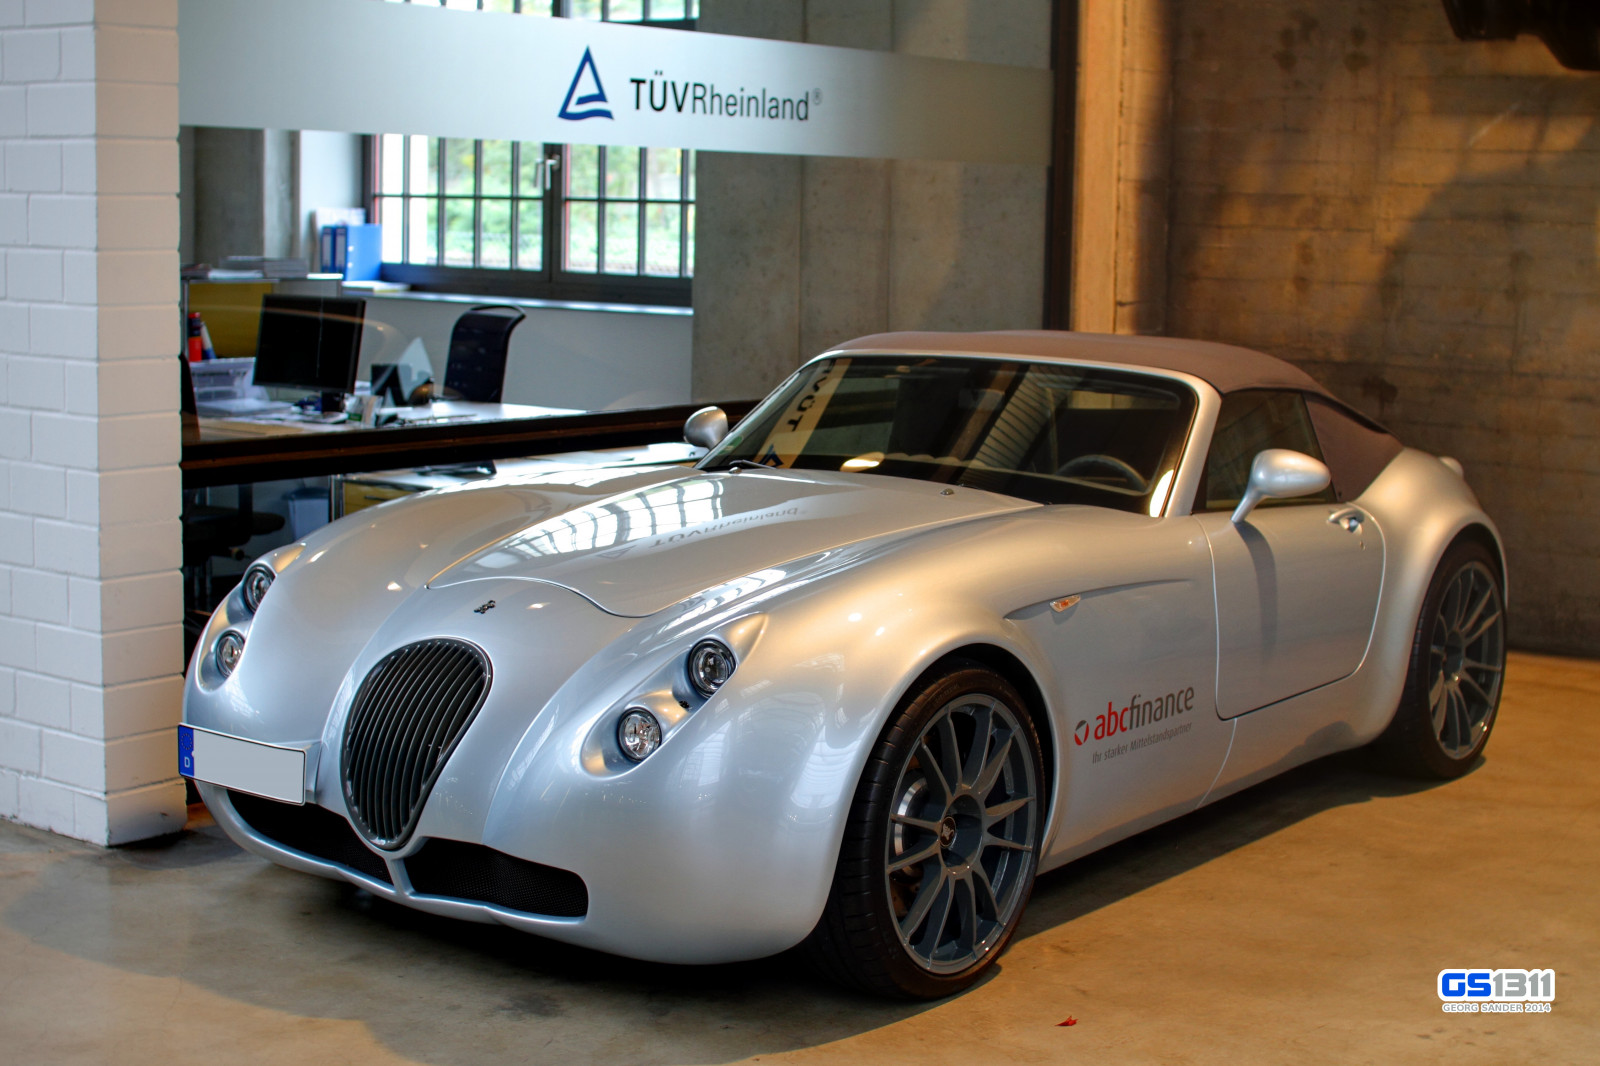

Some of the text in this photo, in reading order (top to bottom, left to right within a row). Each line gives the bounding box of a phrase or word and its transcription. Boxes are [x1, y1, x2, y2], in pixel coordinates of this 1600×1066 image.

[1094, 686, 1194, 740] abcfinance
[184, 756, 191, 768] D
[1092, 722, 1192, 764] Ihr starker Mittelstandspartner
